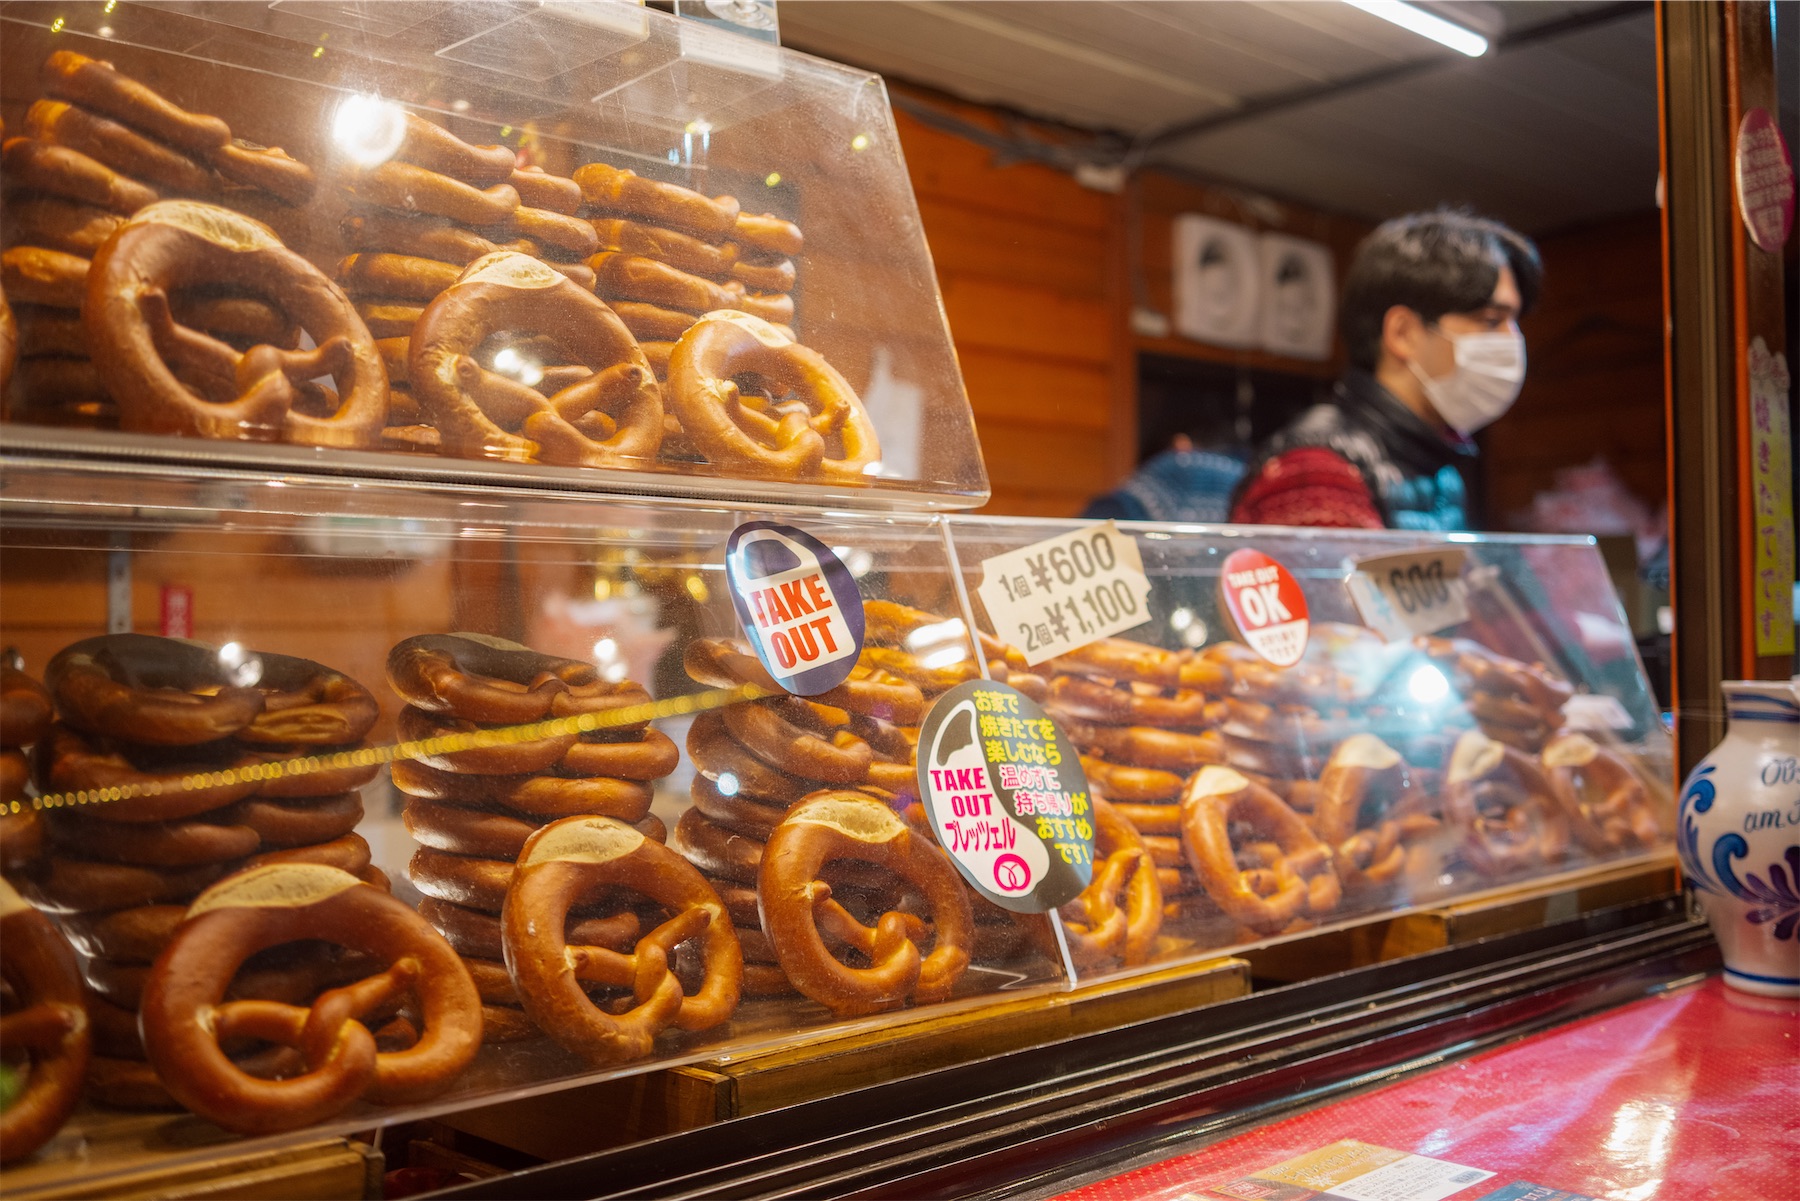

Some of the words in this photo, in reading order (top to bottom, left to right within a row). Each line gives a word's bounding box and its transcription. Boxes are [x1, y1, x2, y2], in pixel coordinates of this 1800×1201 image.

[1228, 570, 1256, 588] TAKE
[1255, 566, 1280, 585] OUT
[749, 573, 833, 628] TAKE
[1240, 584, 1292, 627] OK
[770, 615, 838, 670] OUT
[972, 689, 1020, 714] お家で
[979, 715, 1057, 741] 焼きたてを
[986, 741, 1063, 766] 楽しむなら
[930, 767, 987, 791] TAKE
[1000, 764, 1062, 790] 温めずに
[951, 793, 993, 818] OUT
[944, 816, 1017, 853] プレッツェル
[1036, 816, 1094, 842] おすすめ
